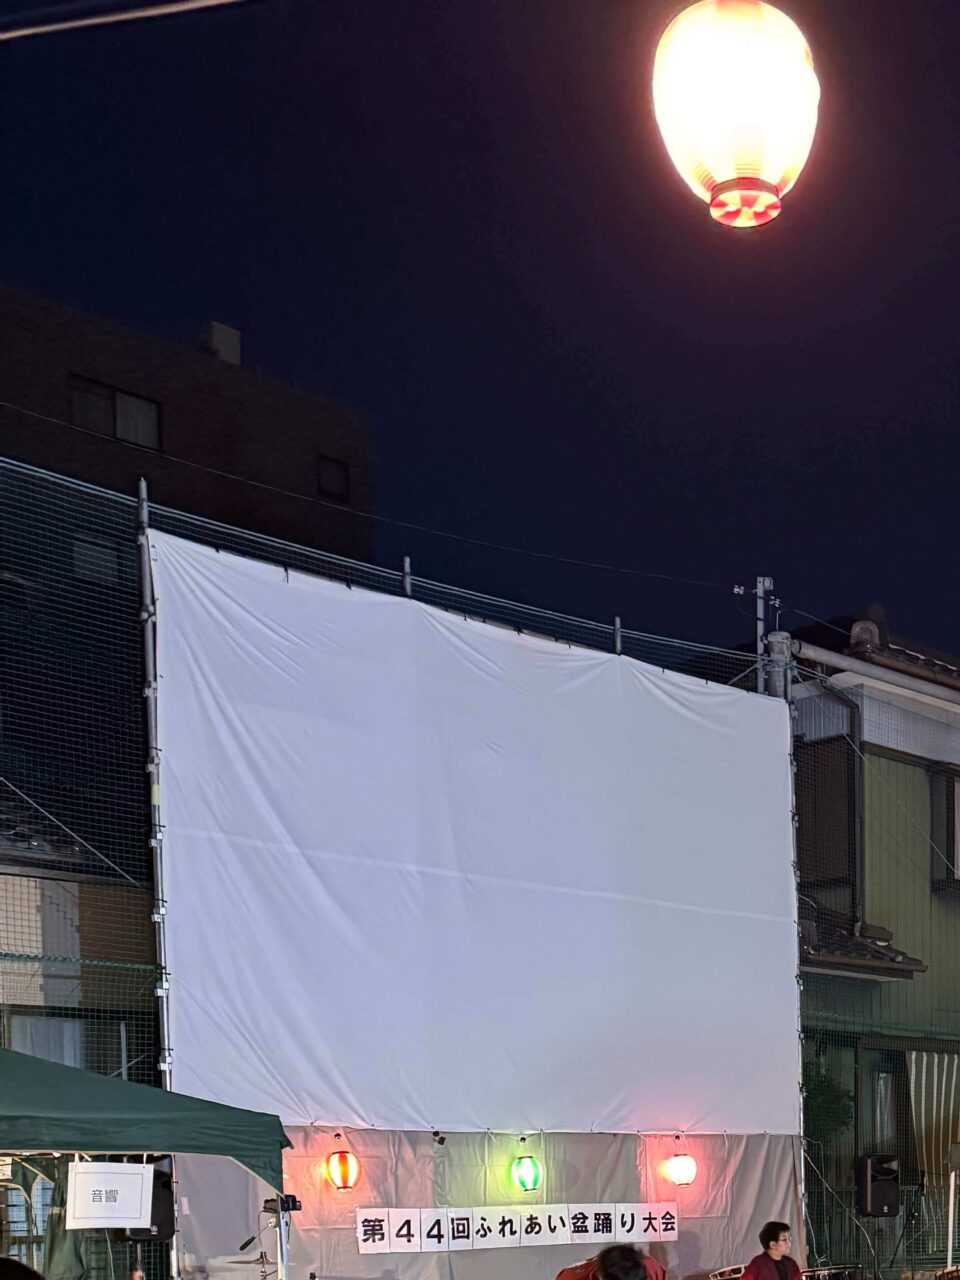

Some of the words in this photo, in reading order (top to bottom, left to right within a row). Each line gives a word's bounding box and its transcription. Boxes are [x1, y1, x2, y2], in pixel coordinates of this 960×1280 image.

[91, 1189, 119, 1203] 音響
[361, 1211, 677, 1244] 第44回ふれあい盆踊り大会
